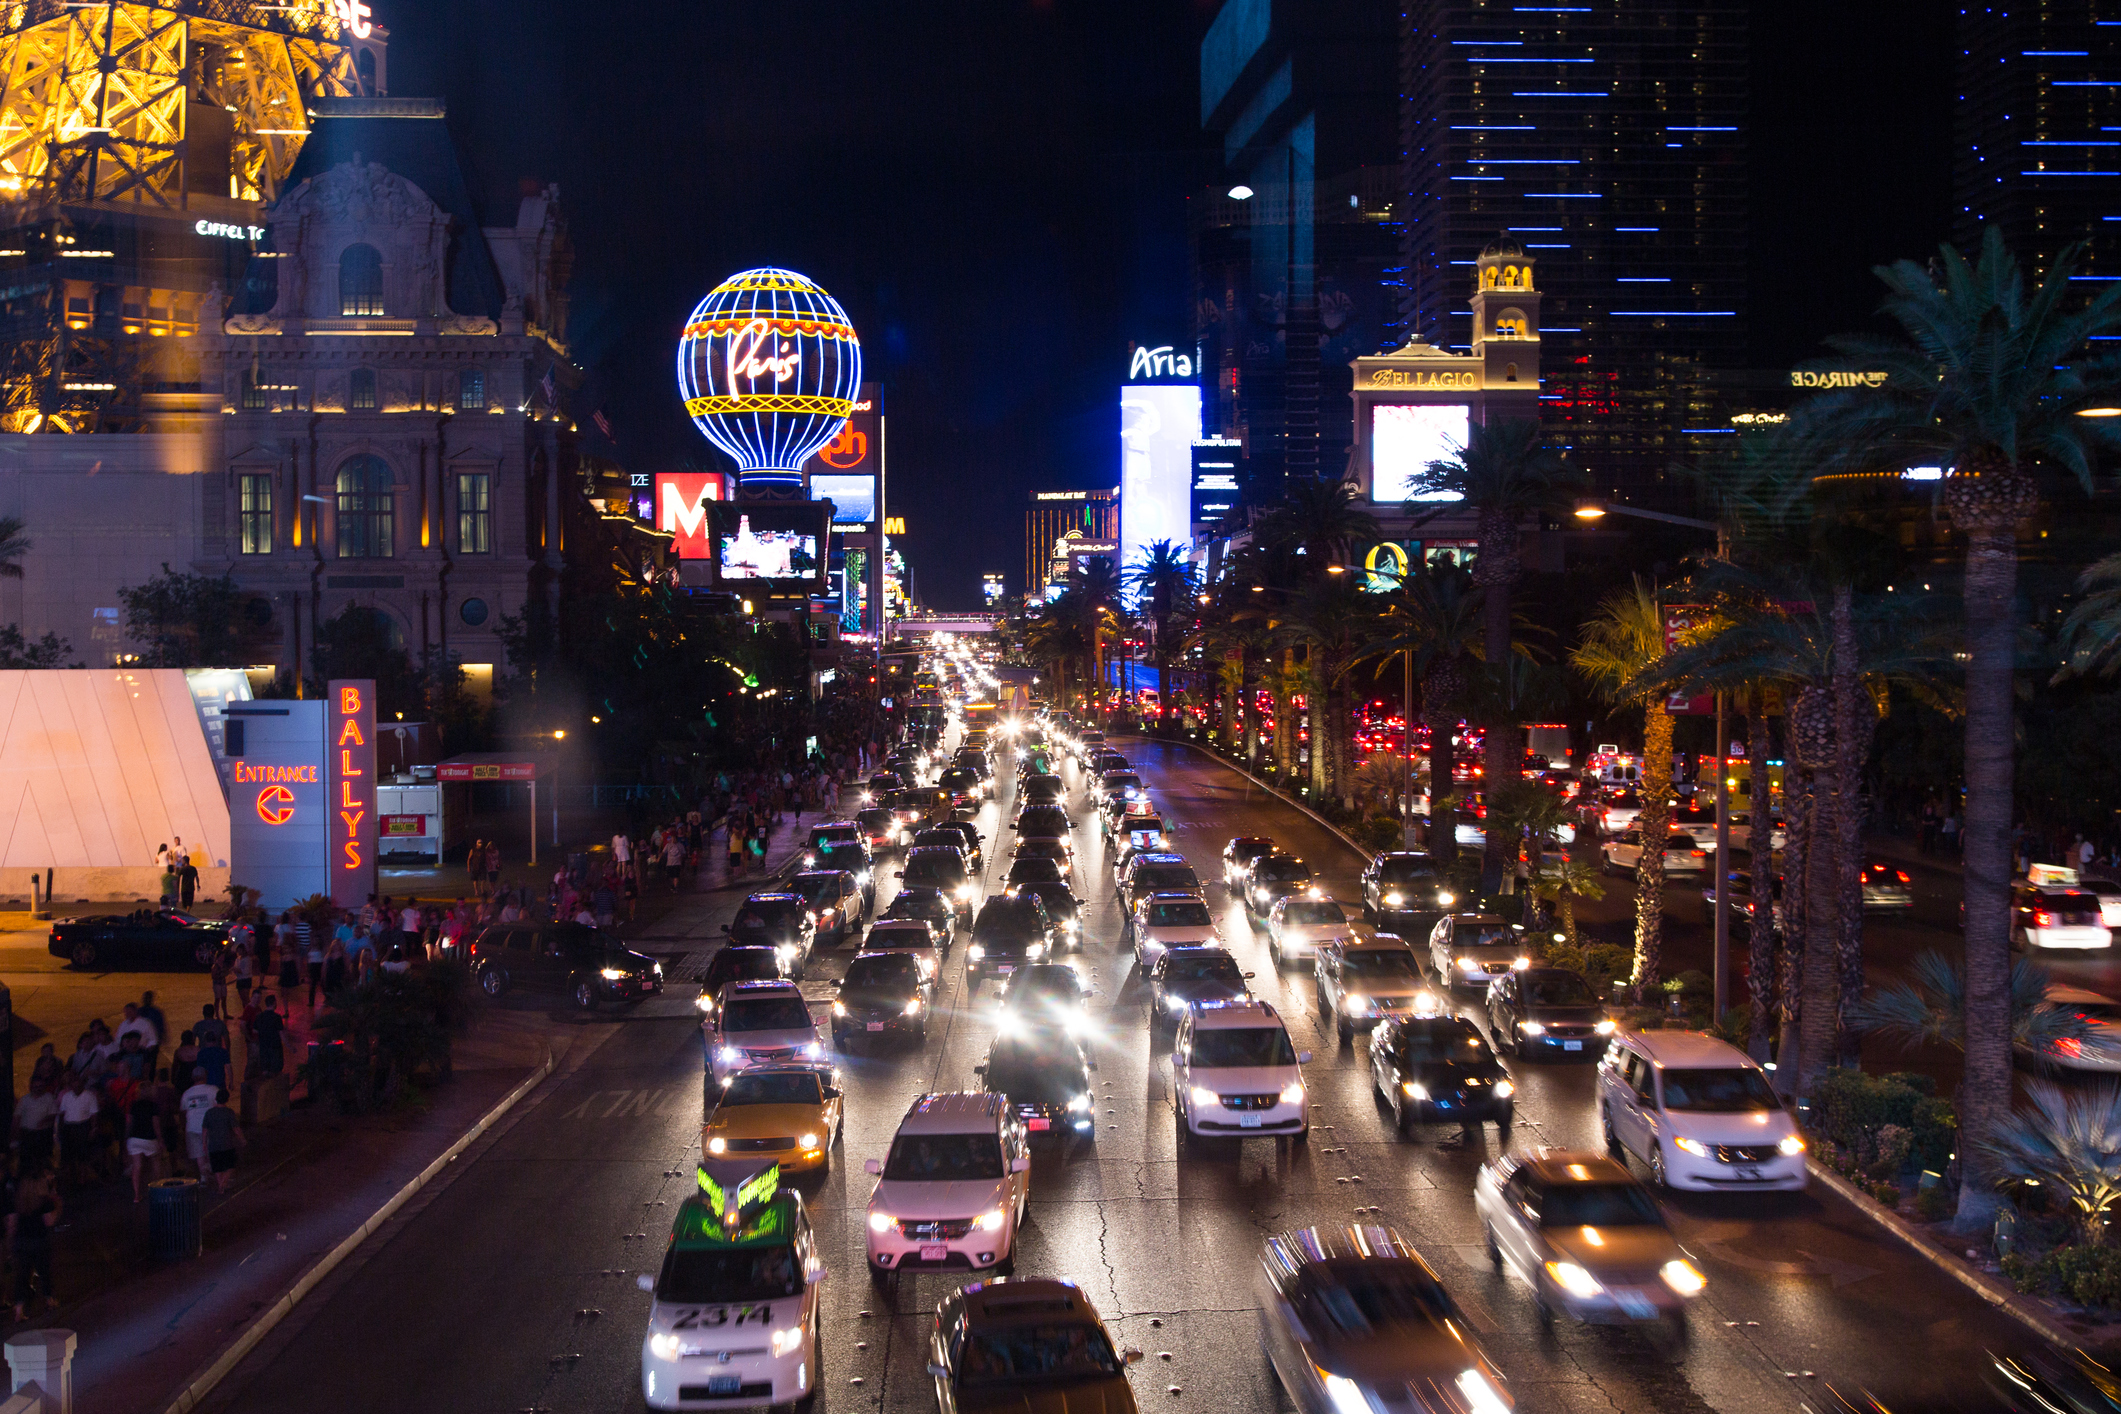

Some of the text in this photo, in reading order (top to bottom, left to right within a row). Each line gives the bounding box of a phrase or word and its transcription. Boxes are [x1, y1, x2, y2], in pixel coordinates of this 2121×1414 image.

[195, 219, 246, 240] EIFFEL
[727, 317, 800, 402] Paris
[1129, 345, 1192, 380] Aria
[1365, 368, 1477, 388] BELLAGIO
[828, 420, 867, 463] ph
[1192, 439, 1242, 447] COSMOPOLITAN
[884, 517, 906, 534] M
[1732, 746, 1743, 754] 30
[235, 760, 318, 783] ENTRANCE
[338, 686, 365, 870] BALLYS
[671, 1302, 775, 1333] 2374
